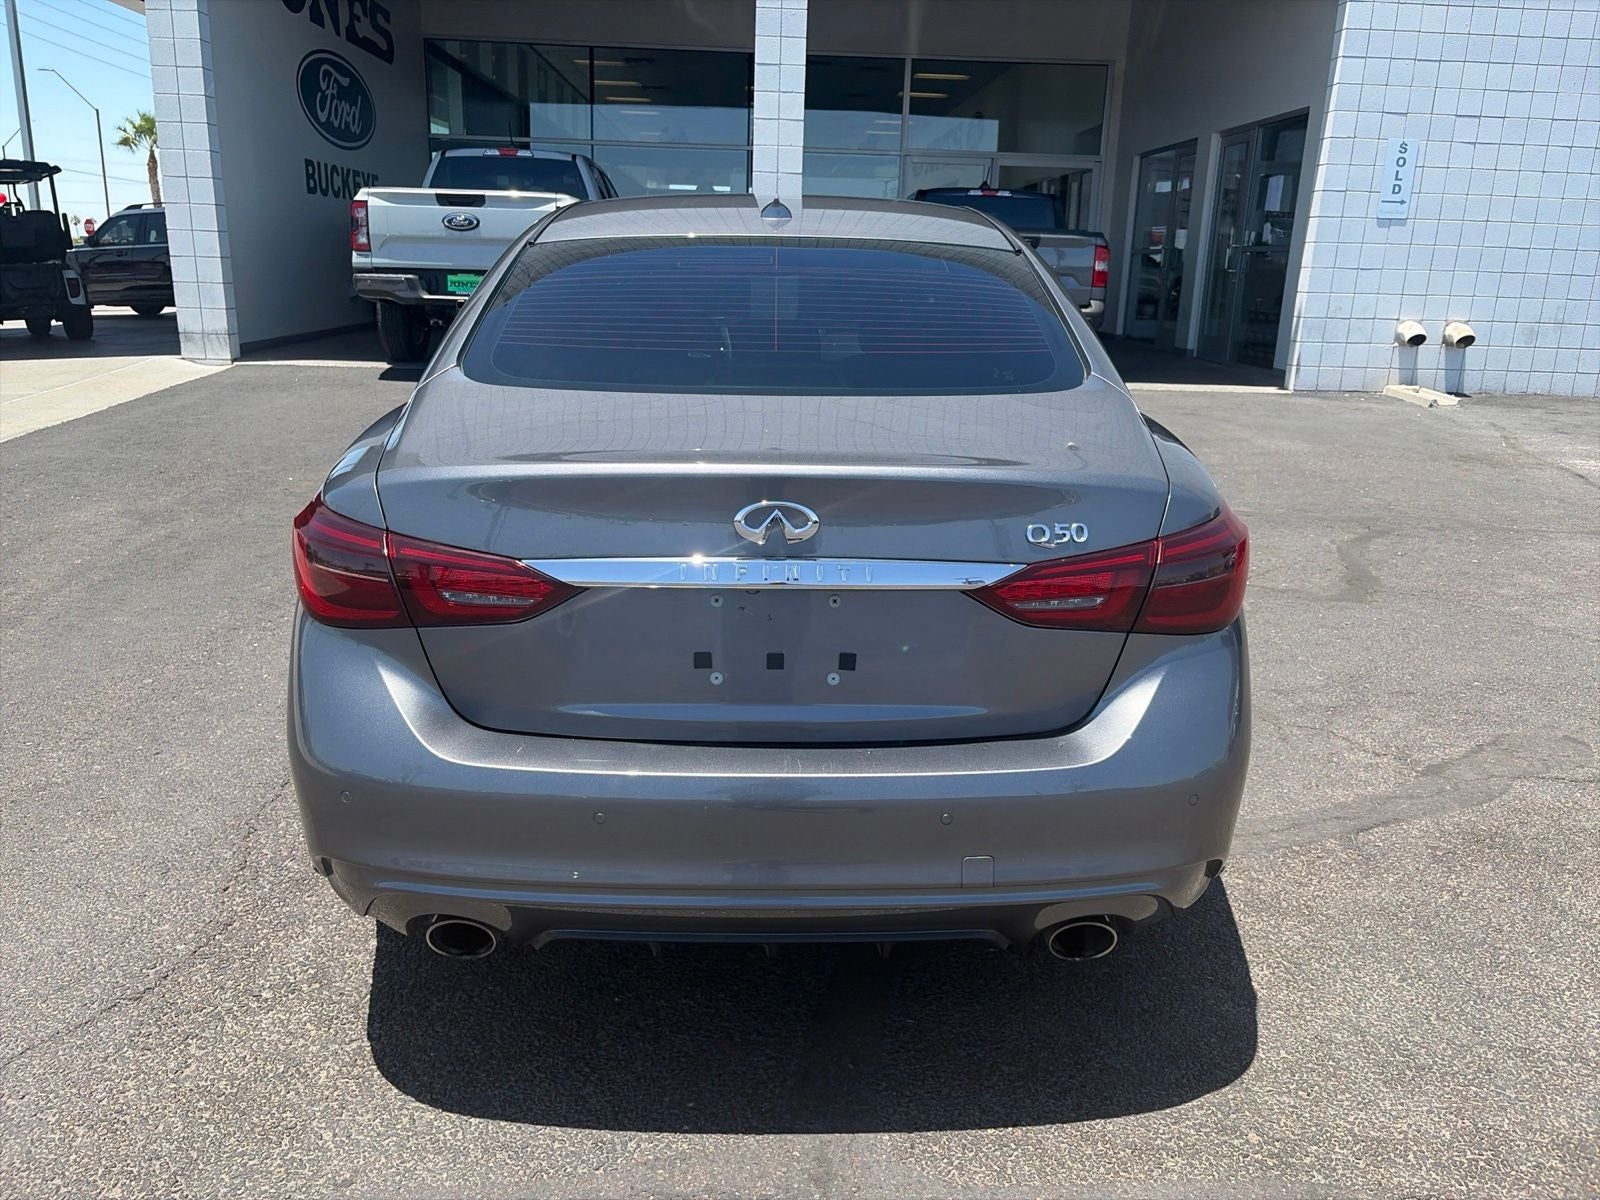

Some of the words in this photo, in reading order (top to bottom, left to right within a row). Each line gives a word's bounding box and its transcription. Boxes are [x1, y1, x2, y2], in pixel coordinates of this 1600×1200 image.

[282, 0, 395, 65] NES
[316, 64, 362, 135] Ford
[1390, 141, 1408, 194] SOLD
[1026, 522, 1089, 548] Q50
[679, 562, 873, 581] INFINITI
